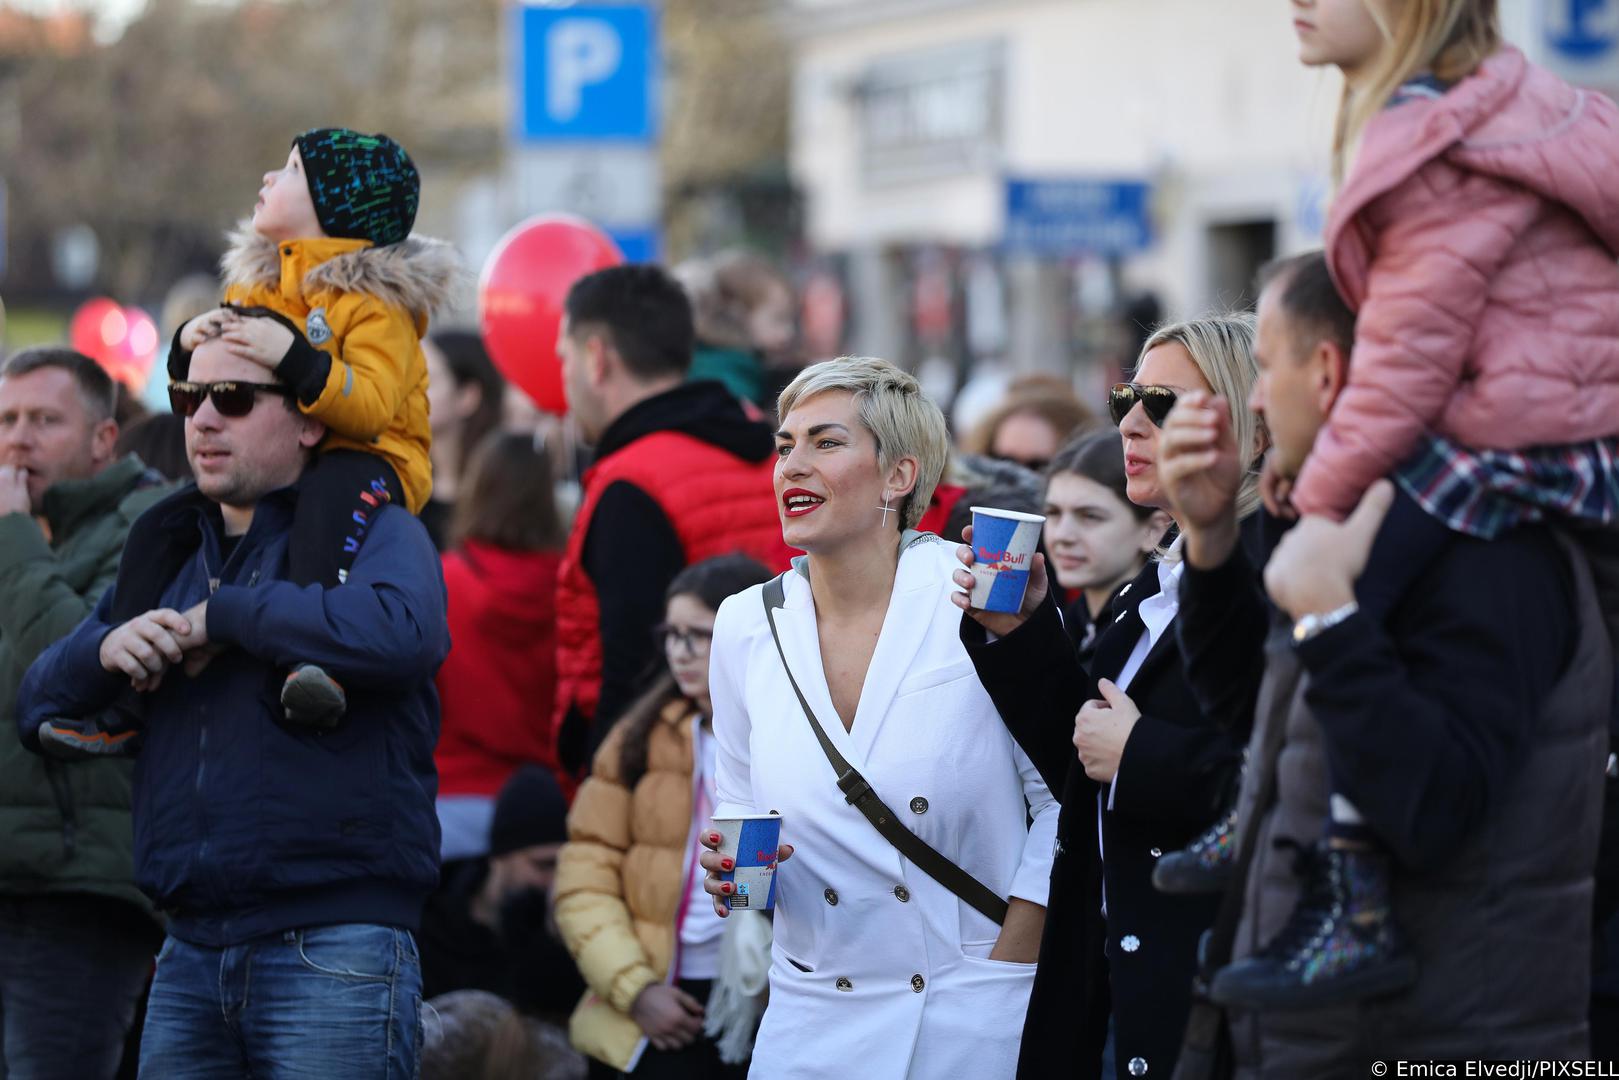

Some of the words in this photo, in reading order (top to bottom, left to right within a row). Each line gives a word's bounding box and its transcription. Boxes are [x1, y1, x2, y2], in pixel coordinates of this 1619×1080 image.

[547, 18, 622, 119] P
[979, 546, 1001, 561] Red
[1002, 551, 1025, 565] Bull
